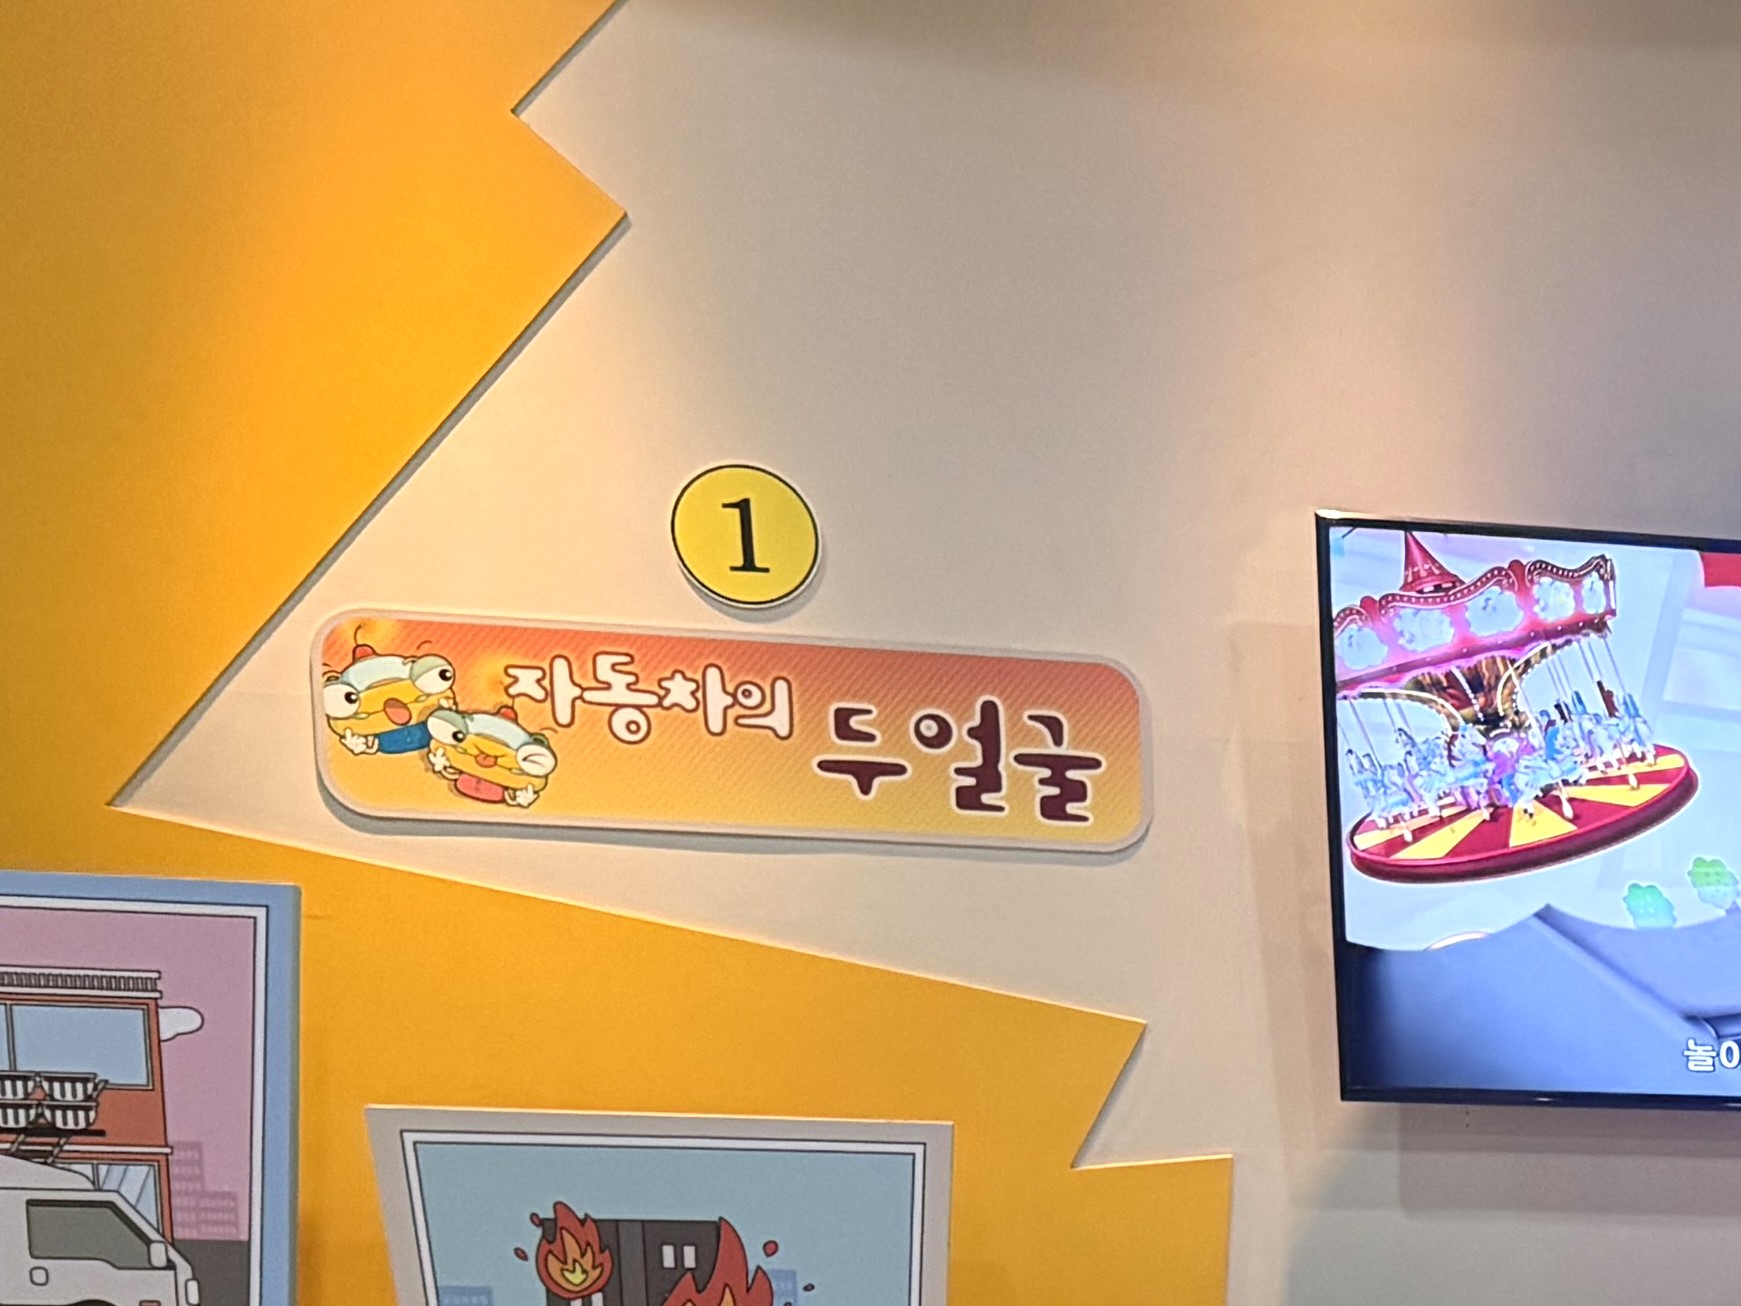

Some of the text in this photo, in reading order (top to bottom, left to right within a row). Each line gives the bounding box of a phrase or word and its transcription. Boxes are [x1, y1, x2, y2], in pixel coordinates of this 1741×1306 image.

[719, 496, 771, 576] 1
[504, 651, 1105, 824] 자동차의 두 얼굴
